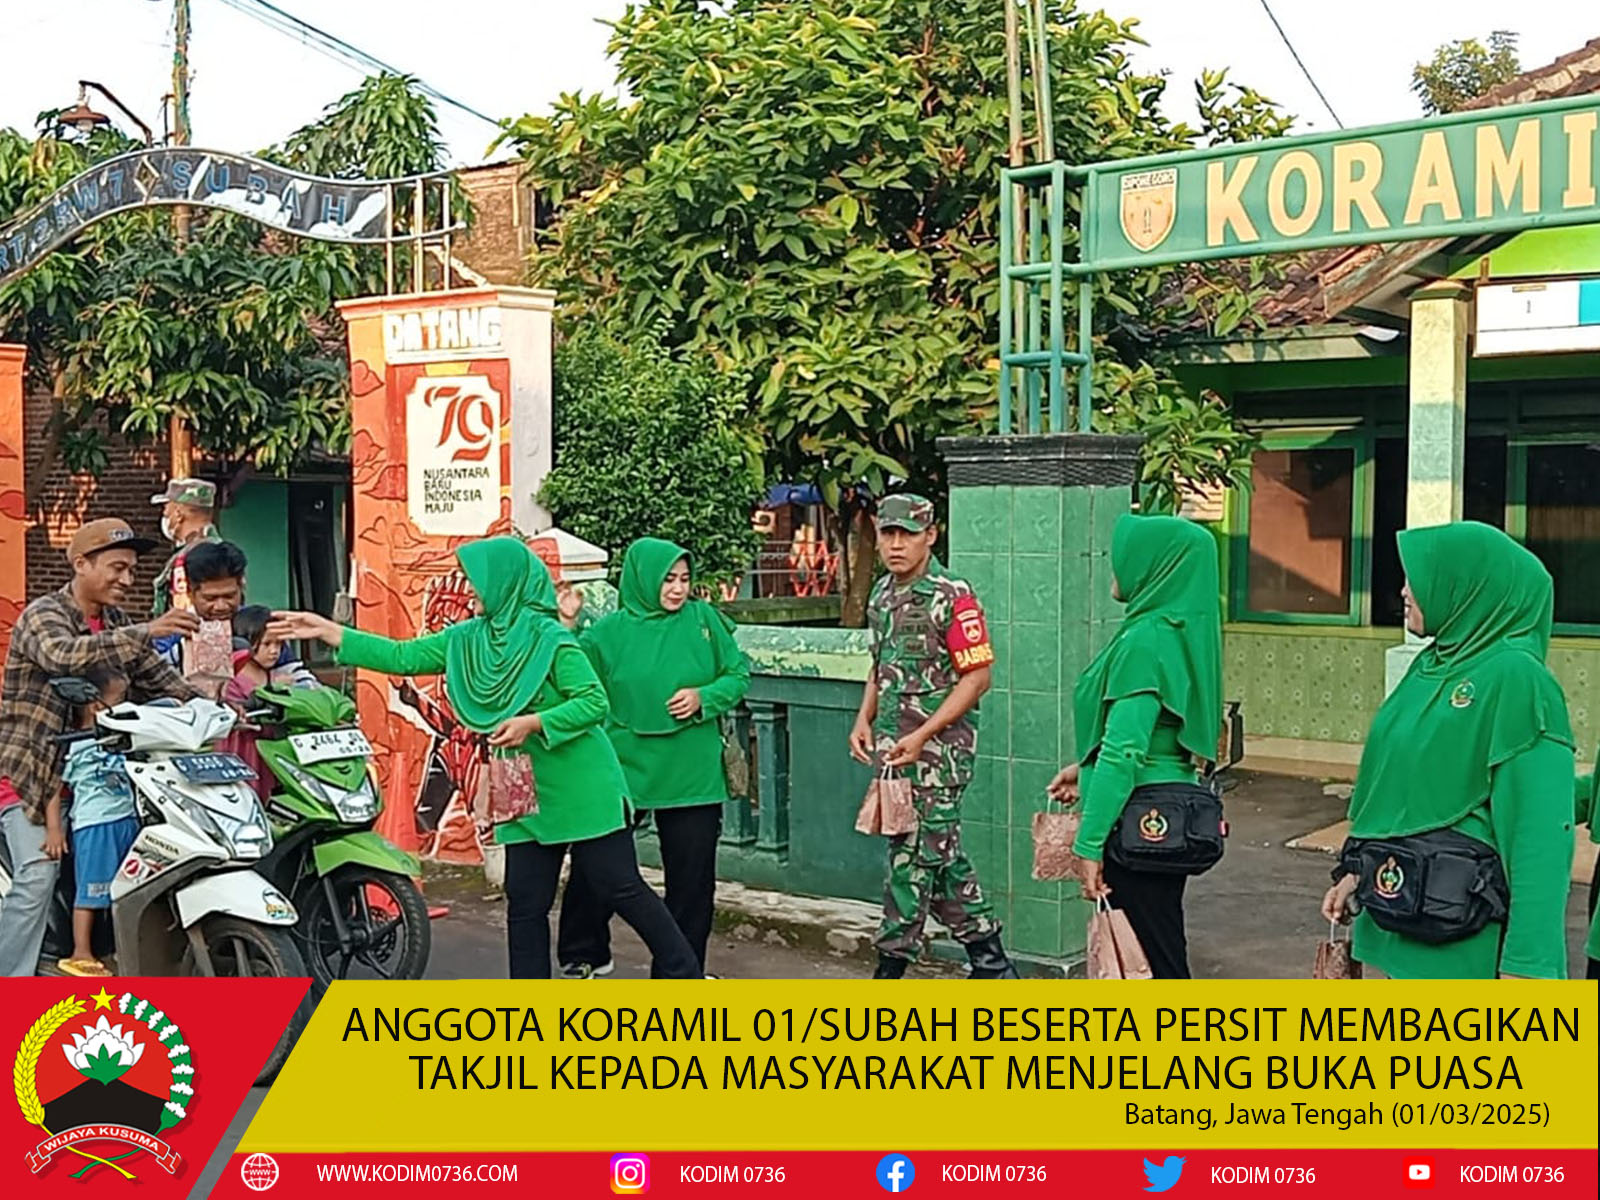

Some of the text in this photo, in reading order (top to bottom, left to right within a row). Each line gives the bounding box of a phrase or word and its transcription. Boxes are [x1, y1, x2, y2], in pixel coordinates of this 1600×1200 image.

[1206, 111, 1598, 247] KORAMI
[172, 160, 348, 227] SUBAH
[424, 386, 494, 463] 79
[423, 467, 490, 480] NUSANTARA
[424, 489, 482, 502] INDONESIA
[425, 502, 454, 514] MAJU
[144, 834, 179, 855] HONDA
